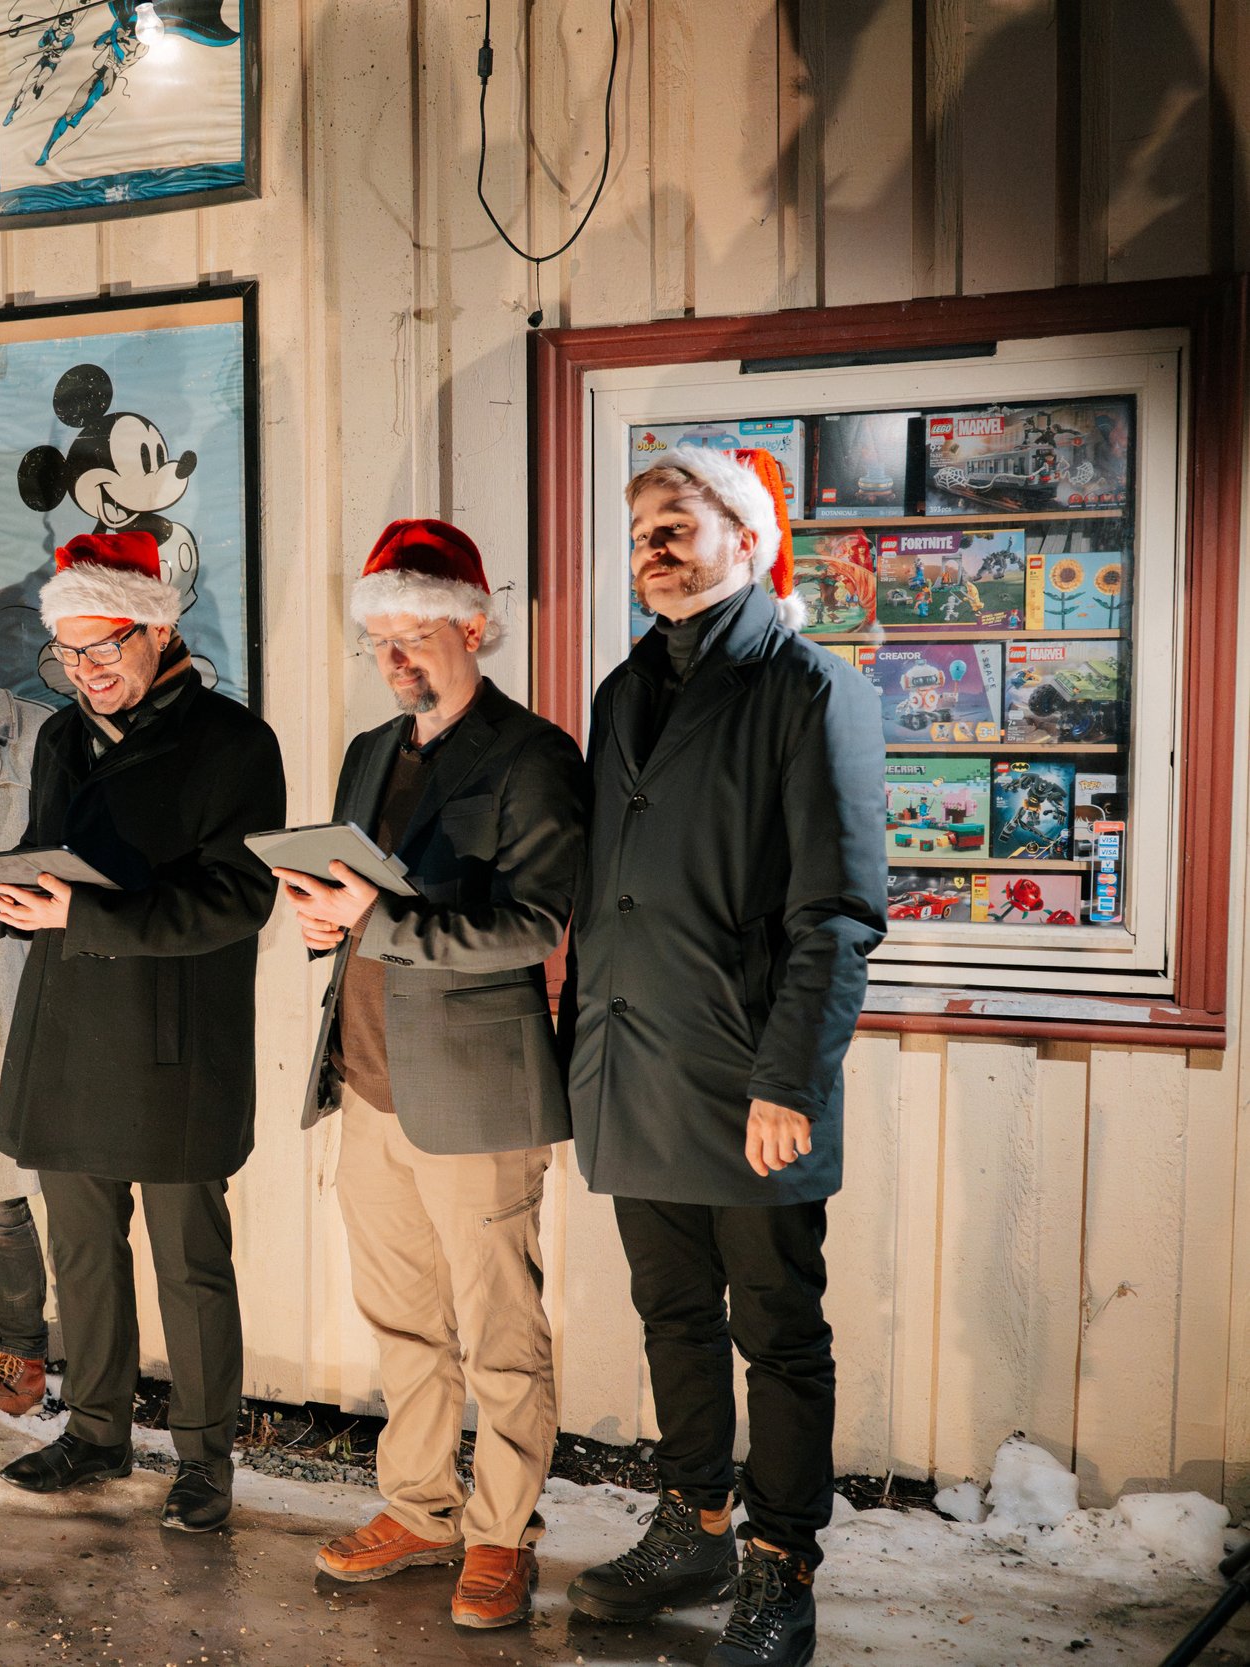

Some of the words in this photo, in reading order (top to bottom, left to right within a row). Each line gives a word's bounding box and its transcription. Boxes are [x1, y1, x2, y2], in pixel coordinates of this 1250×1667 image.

[931, 424, 953, 434] LEGO
[958, 418, 1003, 436] MARVEL
[636, 438, 667, 453] duplo
[930, 443, 942, 452] 9+
[901, 535, 954, 552] FORTNITE
[878, 652, 922, 660] CREATOR
[1031, 648, 1064, 660] MARVEL
